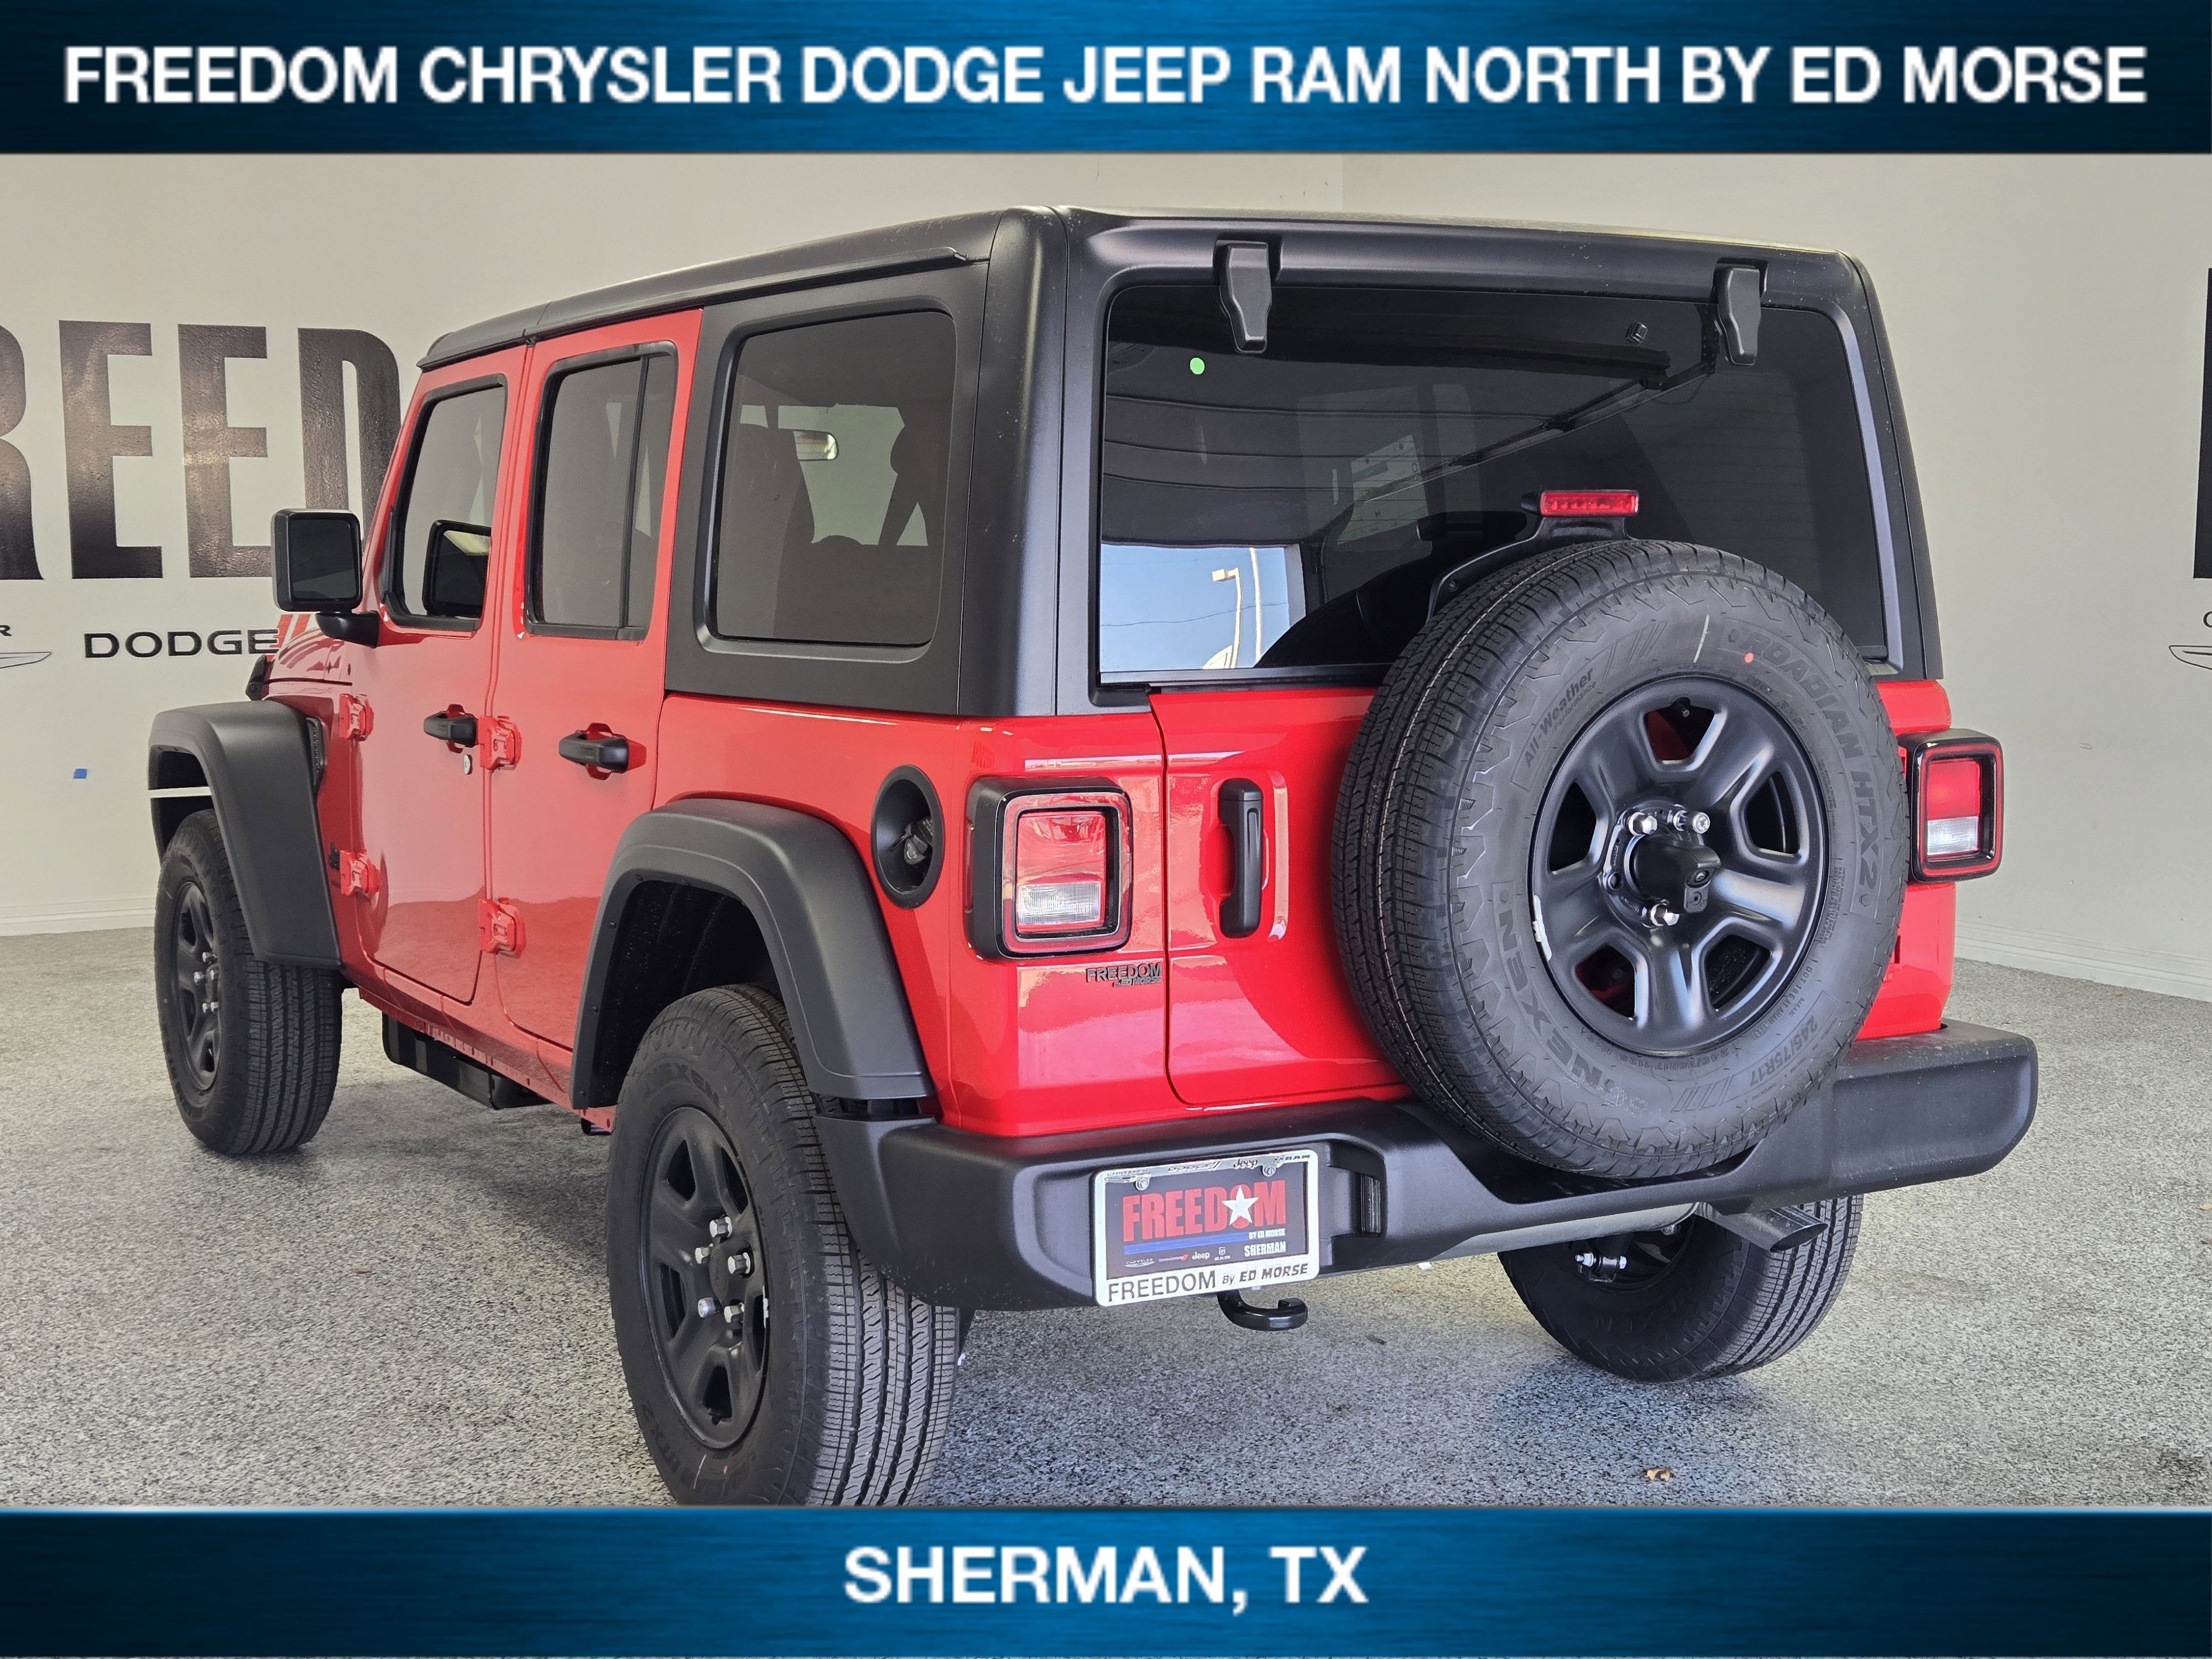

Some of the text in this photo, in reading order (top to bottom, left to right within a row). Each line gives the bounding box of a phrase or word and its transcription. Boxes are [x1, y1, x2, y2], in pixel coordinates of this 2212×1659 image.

[85, 629, 279, 658] DODGE
[1524, 669, 1593, 768] All-Weather
[1740, 630, 1865, 759] ROADIAN
[1851, 771, 1879, 887] HTX2
[1086, 962, 1161, 983] FREEDOM
[1498, 910, 1604, 1089] NEXEN
[1233, 1159, 1258, 1170] Jeep
[1192, 1251, 1210, 1260] Jeep
[1244, 1240, 1287, 1258] SHERMAN
[1108, 1270, 1215, 1302] FREEDOM
[1239, 1270, 1256, 1282] ED
[1261, 1263, 1308, 1280] MORSE
